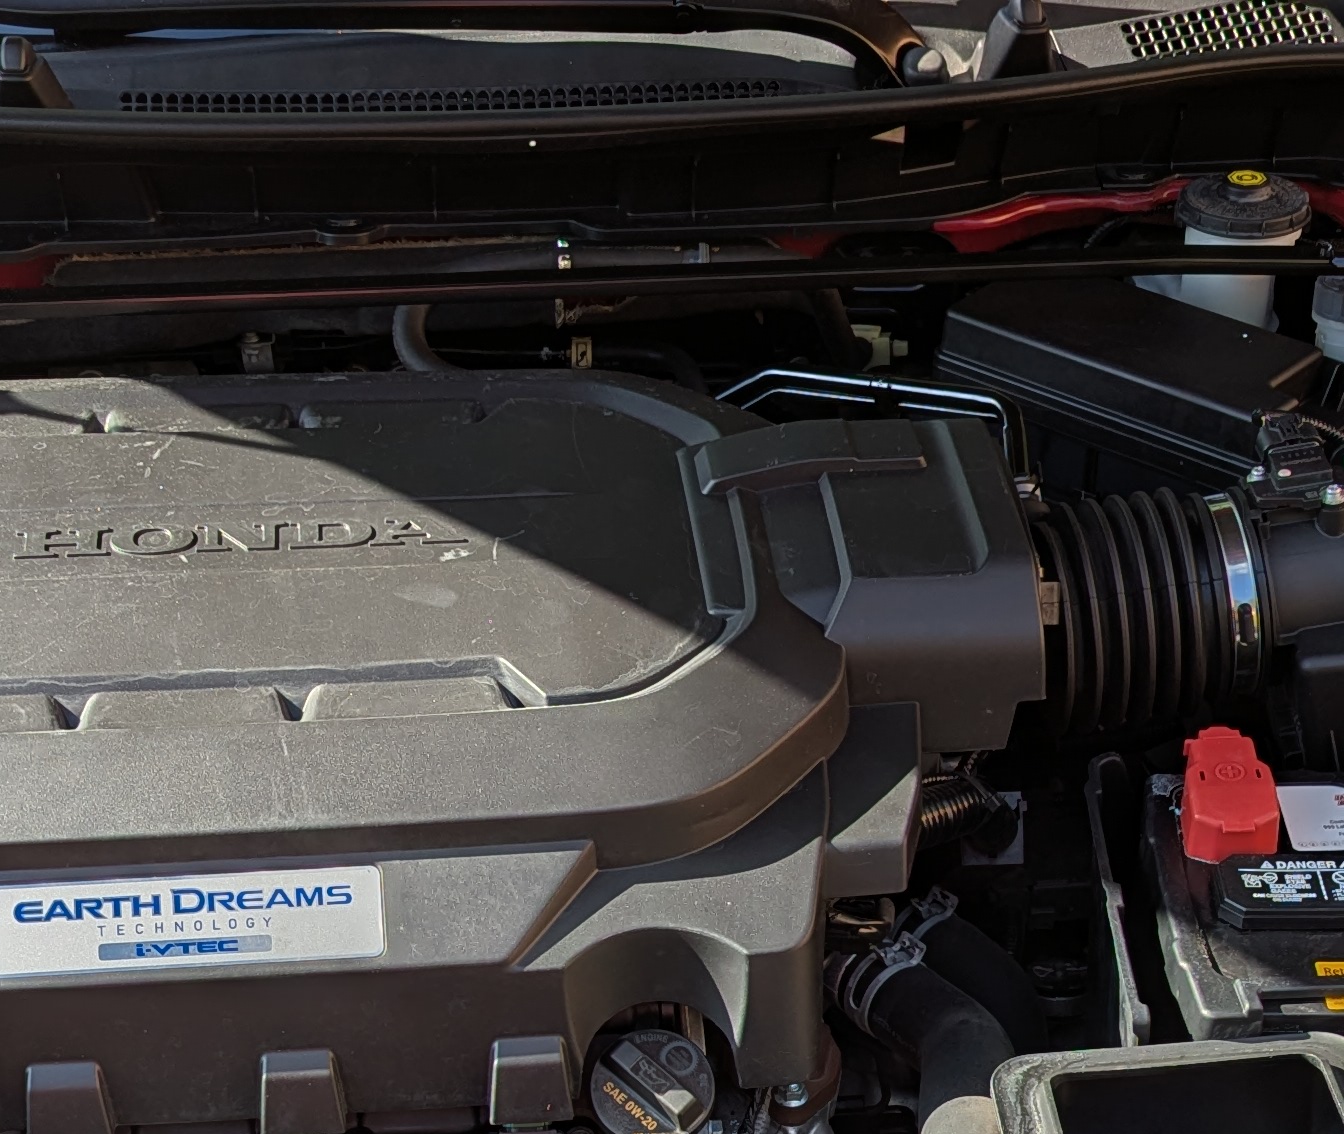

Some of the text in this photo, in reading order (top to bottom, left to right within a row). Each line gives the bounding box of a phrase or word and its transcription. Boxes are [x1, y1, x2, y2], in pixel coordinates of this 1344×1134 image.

[13, 517, 470, 561] HONDA
[1275, 861, 1336, 869] DANGER
[13, 884, 354, 924] EARTH DREAMS
[97, 916, 273, 938] TECHNOLOGY
[136, 939, 239, 958] i-VTEC
[634, 1034, 669, 1043] ENGINE
[602, 1081, 658, 1131] SAE 0W-20
